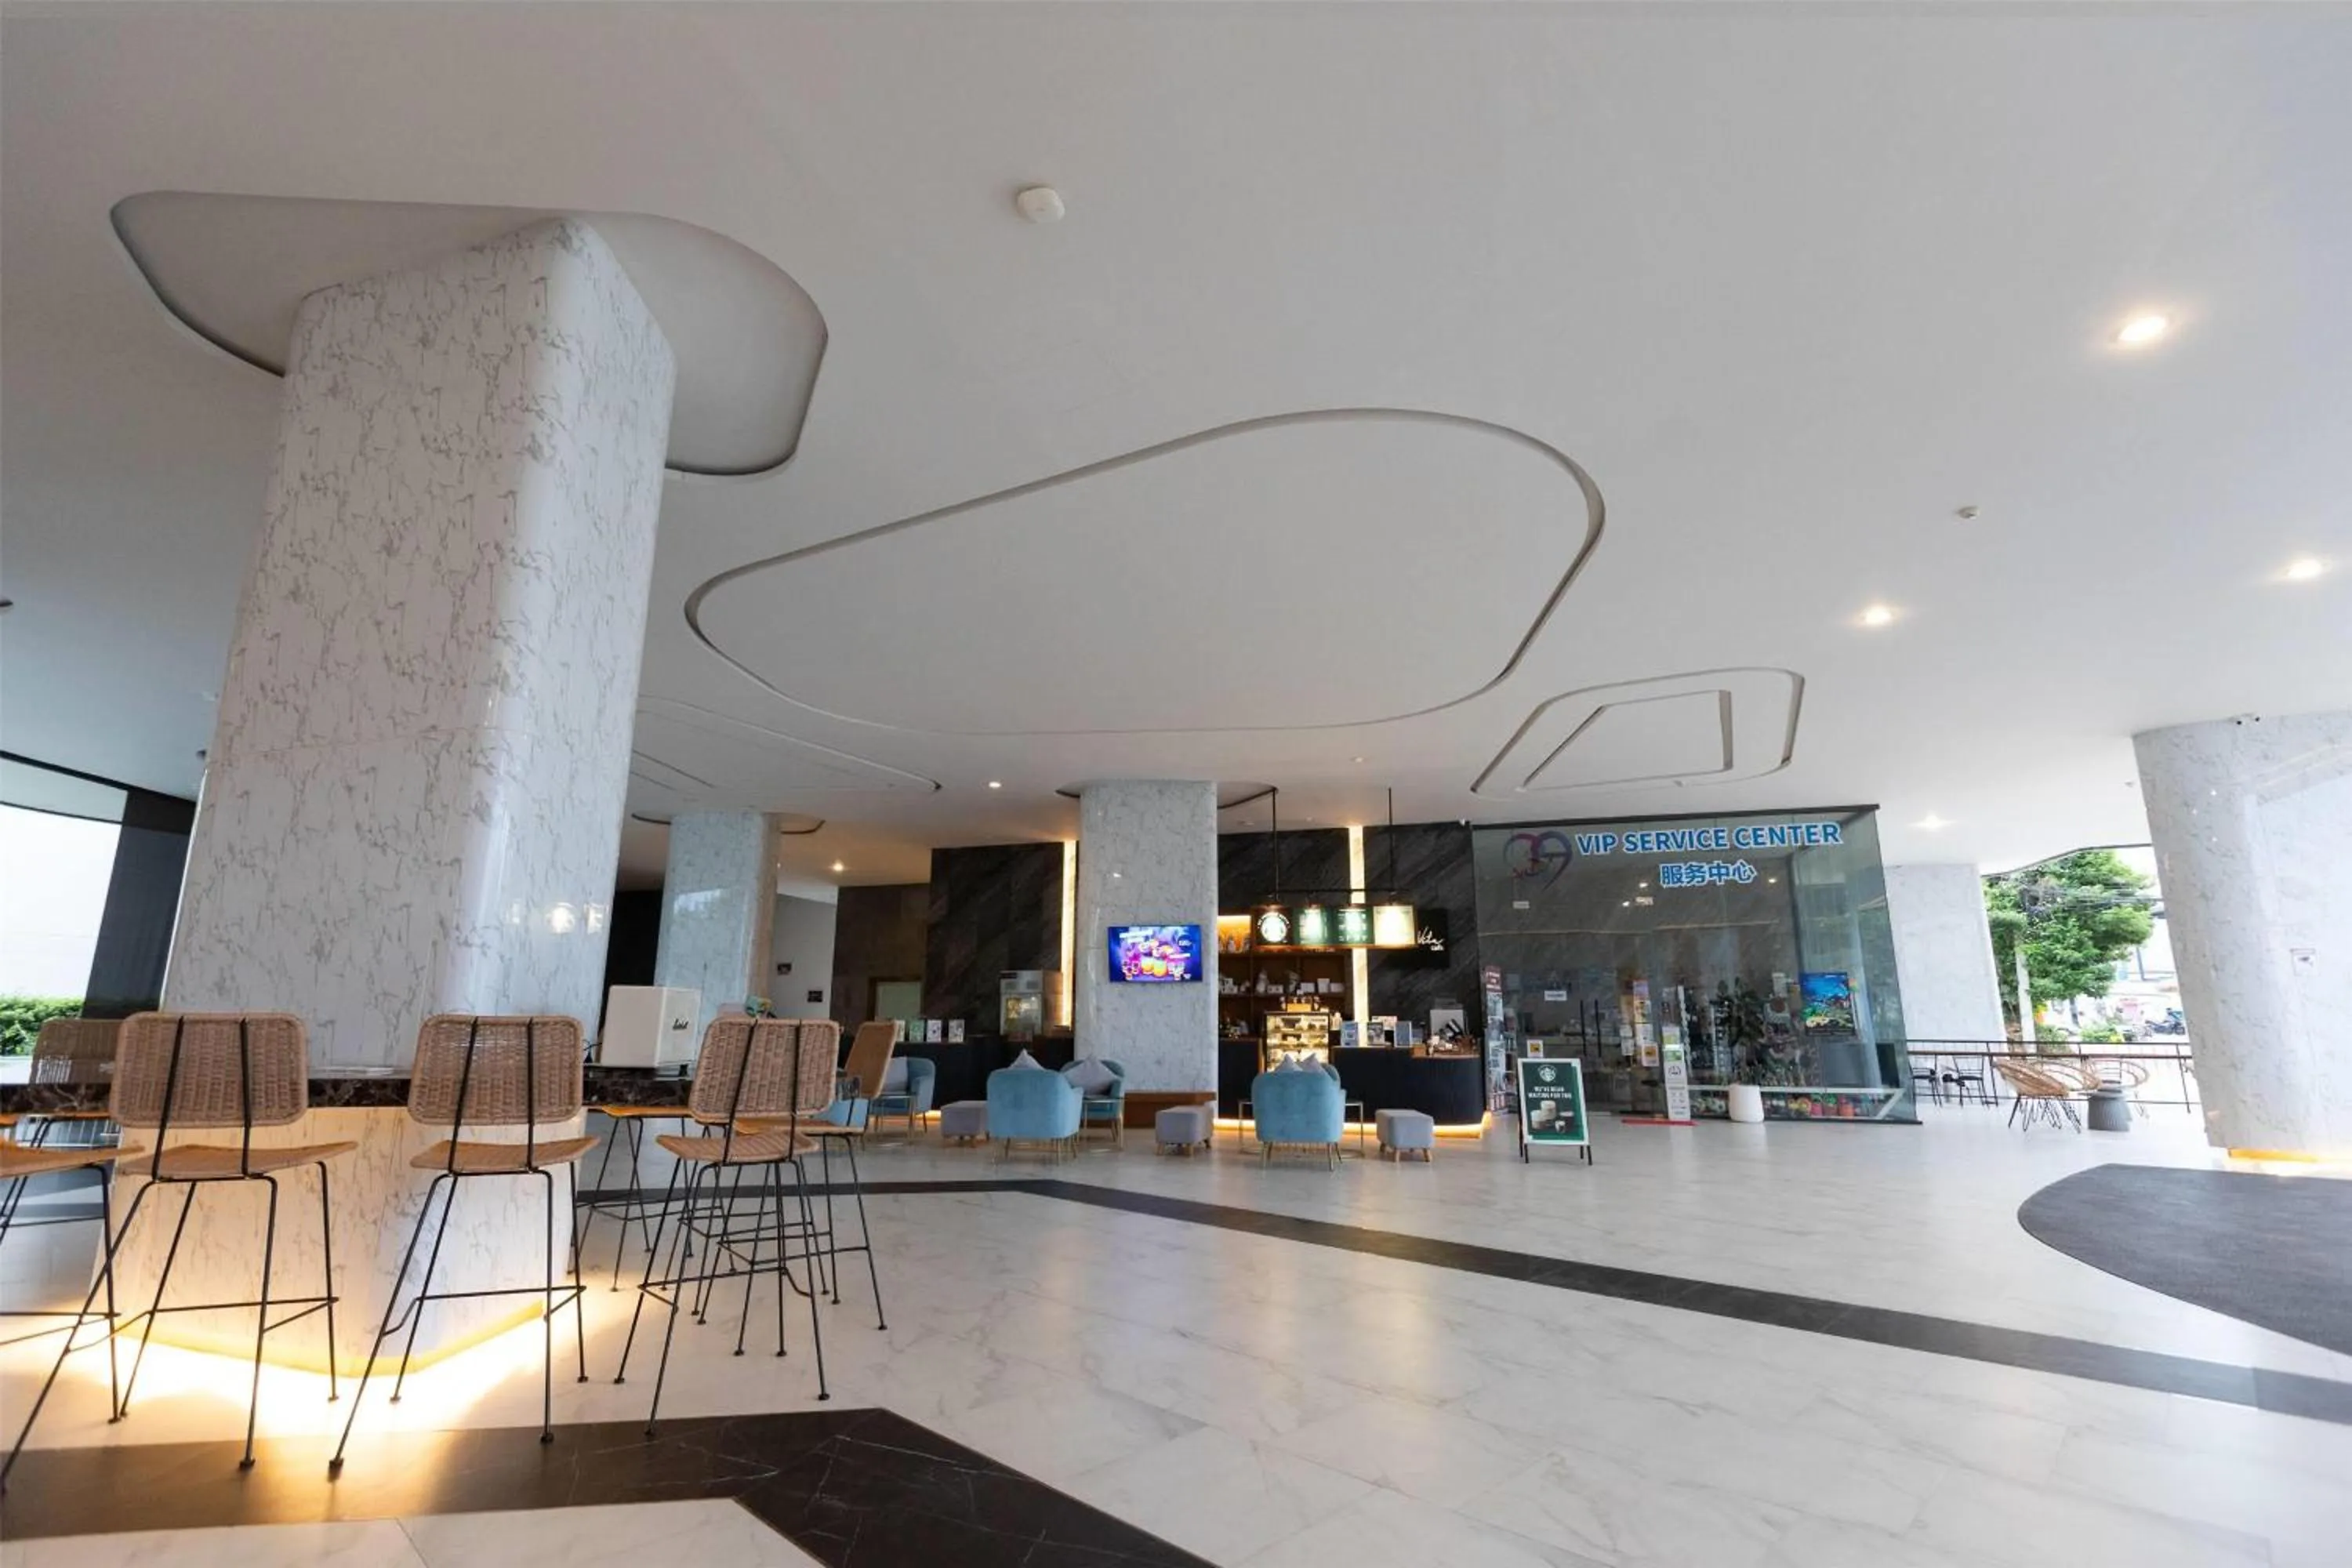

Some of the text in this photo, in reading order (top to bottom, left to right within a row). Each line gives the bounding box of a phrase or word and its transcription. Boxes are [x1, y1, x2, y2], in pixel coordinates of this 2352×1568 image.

[1575, 822, 1843, 855] VIP SERVICE CENTER
[1659, 859, 1757, 887] 服务中心
